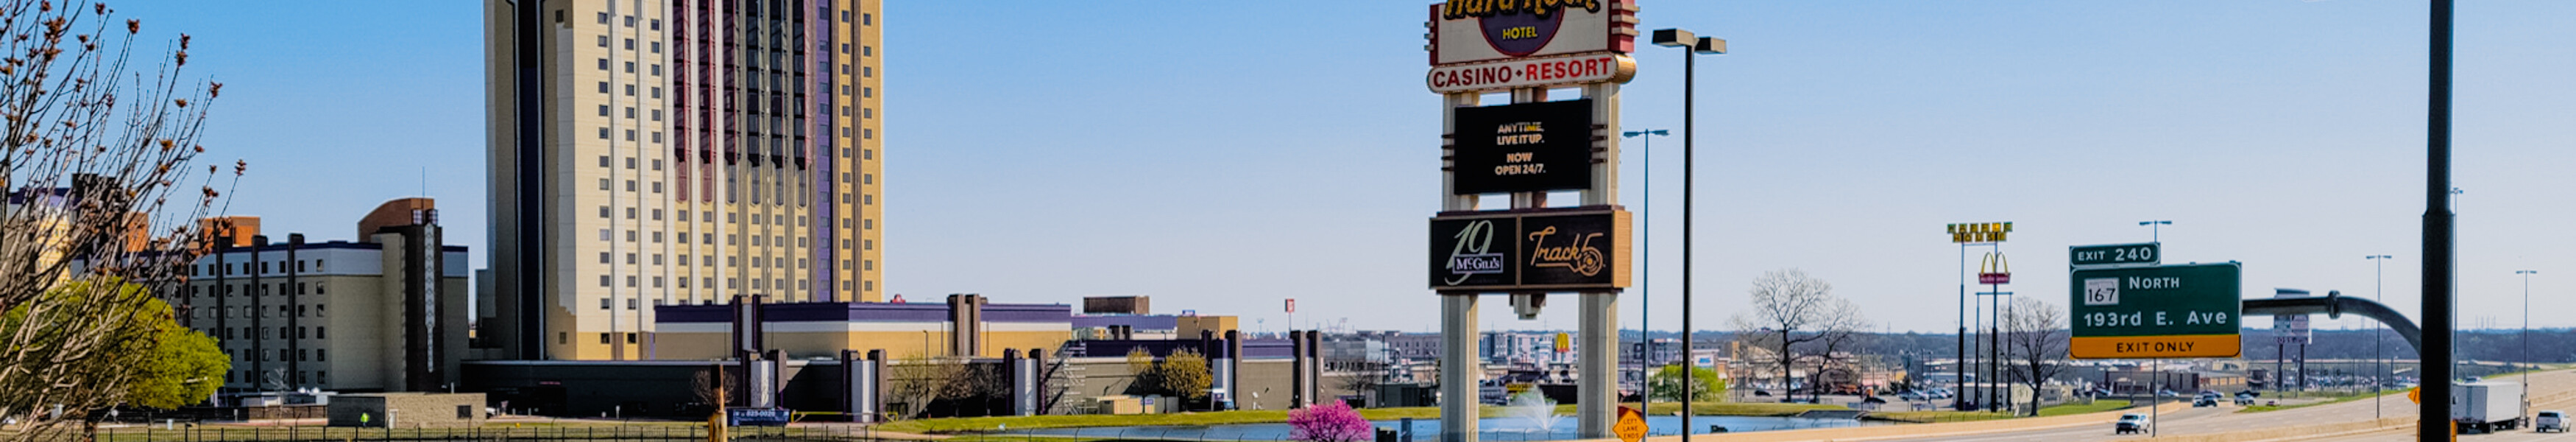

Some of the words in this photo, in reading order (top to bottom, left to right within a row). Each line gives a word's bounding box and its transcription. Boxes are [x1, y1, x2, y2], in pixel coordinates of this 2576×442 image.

[1503, 27, 1537, 39] HOTEL
[1433, 66, 1512, 88] CASINO
[1526, 57, 1612, 81] RESORT
[1497, 135, 1518, 145] LIVE
[1519, 134, 1528, 144] IT
[1507, 152, 1532, 163] NOW
[1495, 164, 1521, 175] OPEN
[1445, 220, 1493, 286] 19
[2078, 250, 2105, 261] EXIT
[2115, 247, 2151, 261] 240
[2129, 276, 2179, 290] NORTH
[2087, 288, 2116, 303] 167
[2084, 311, 2141, 327] 193rd
[2156, 311, 2173, 326] E.
[2187, 310, 2227, 324] Ave
[2116, 342, 2149, 352] EXIT
[2154, 341, 2194, 351] ONLY
